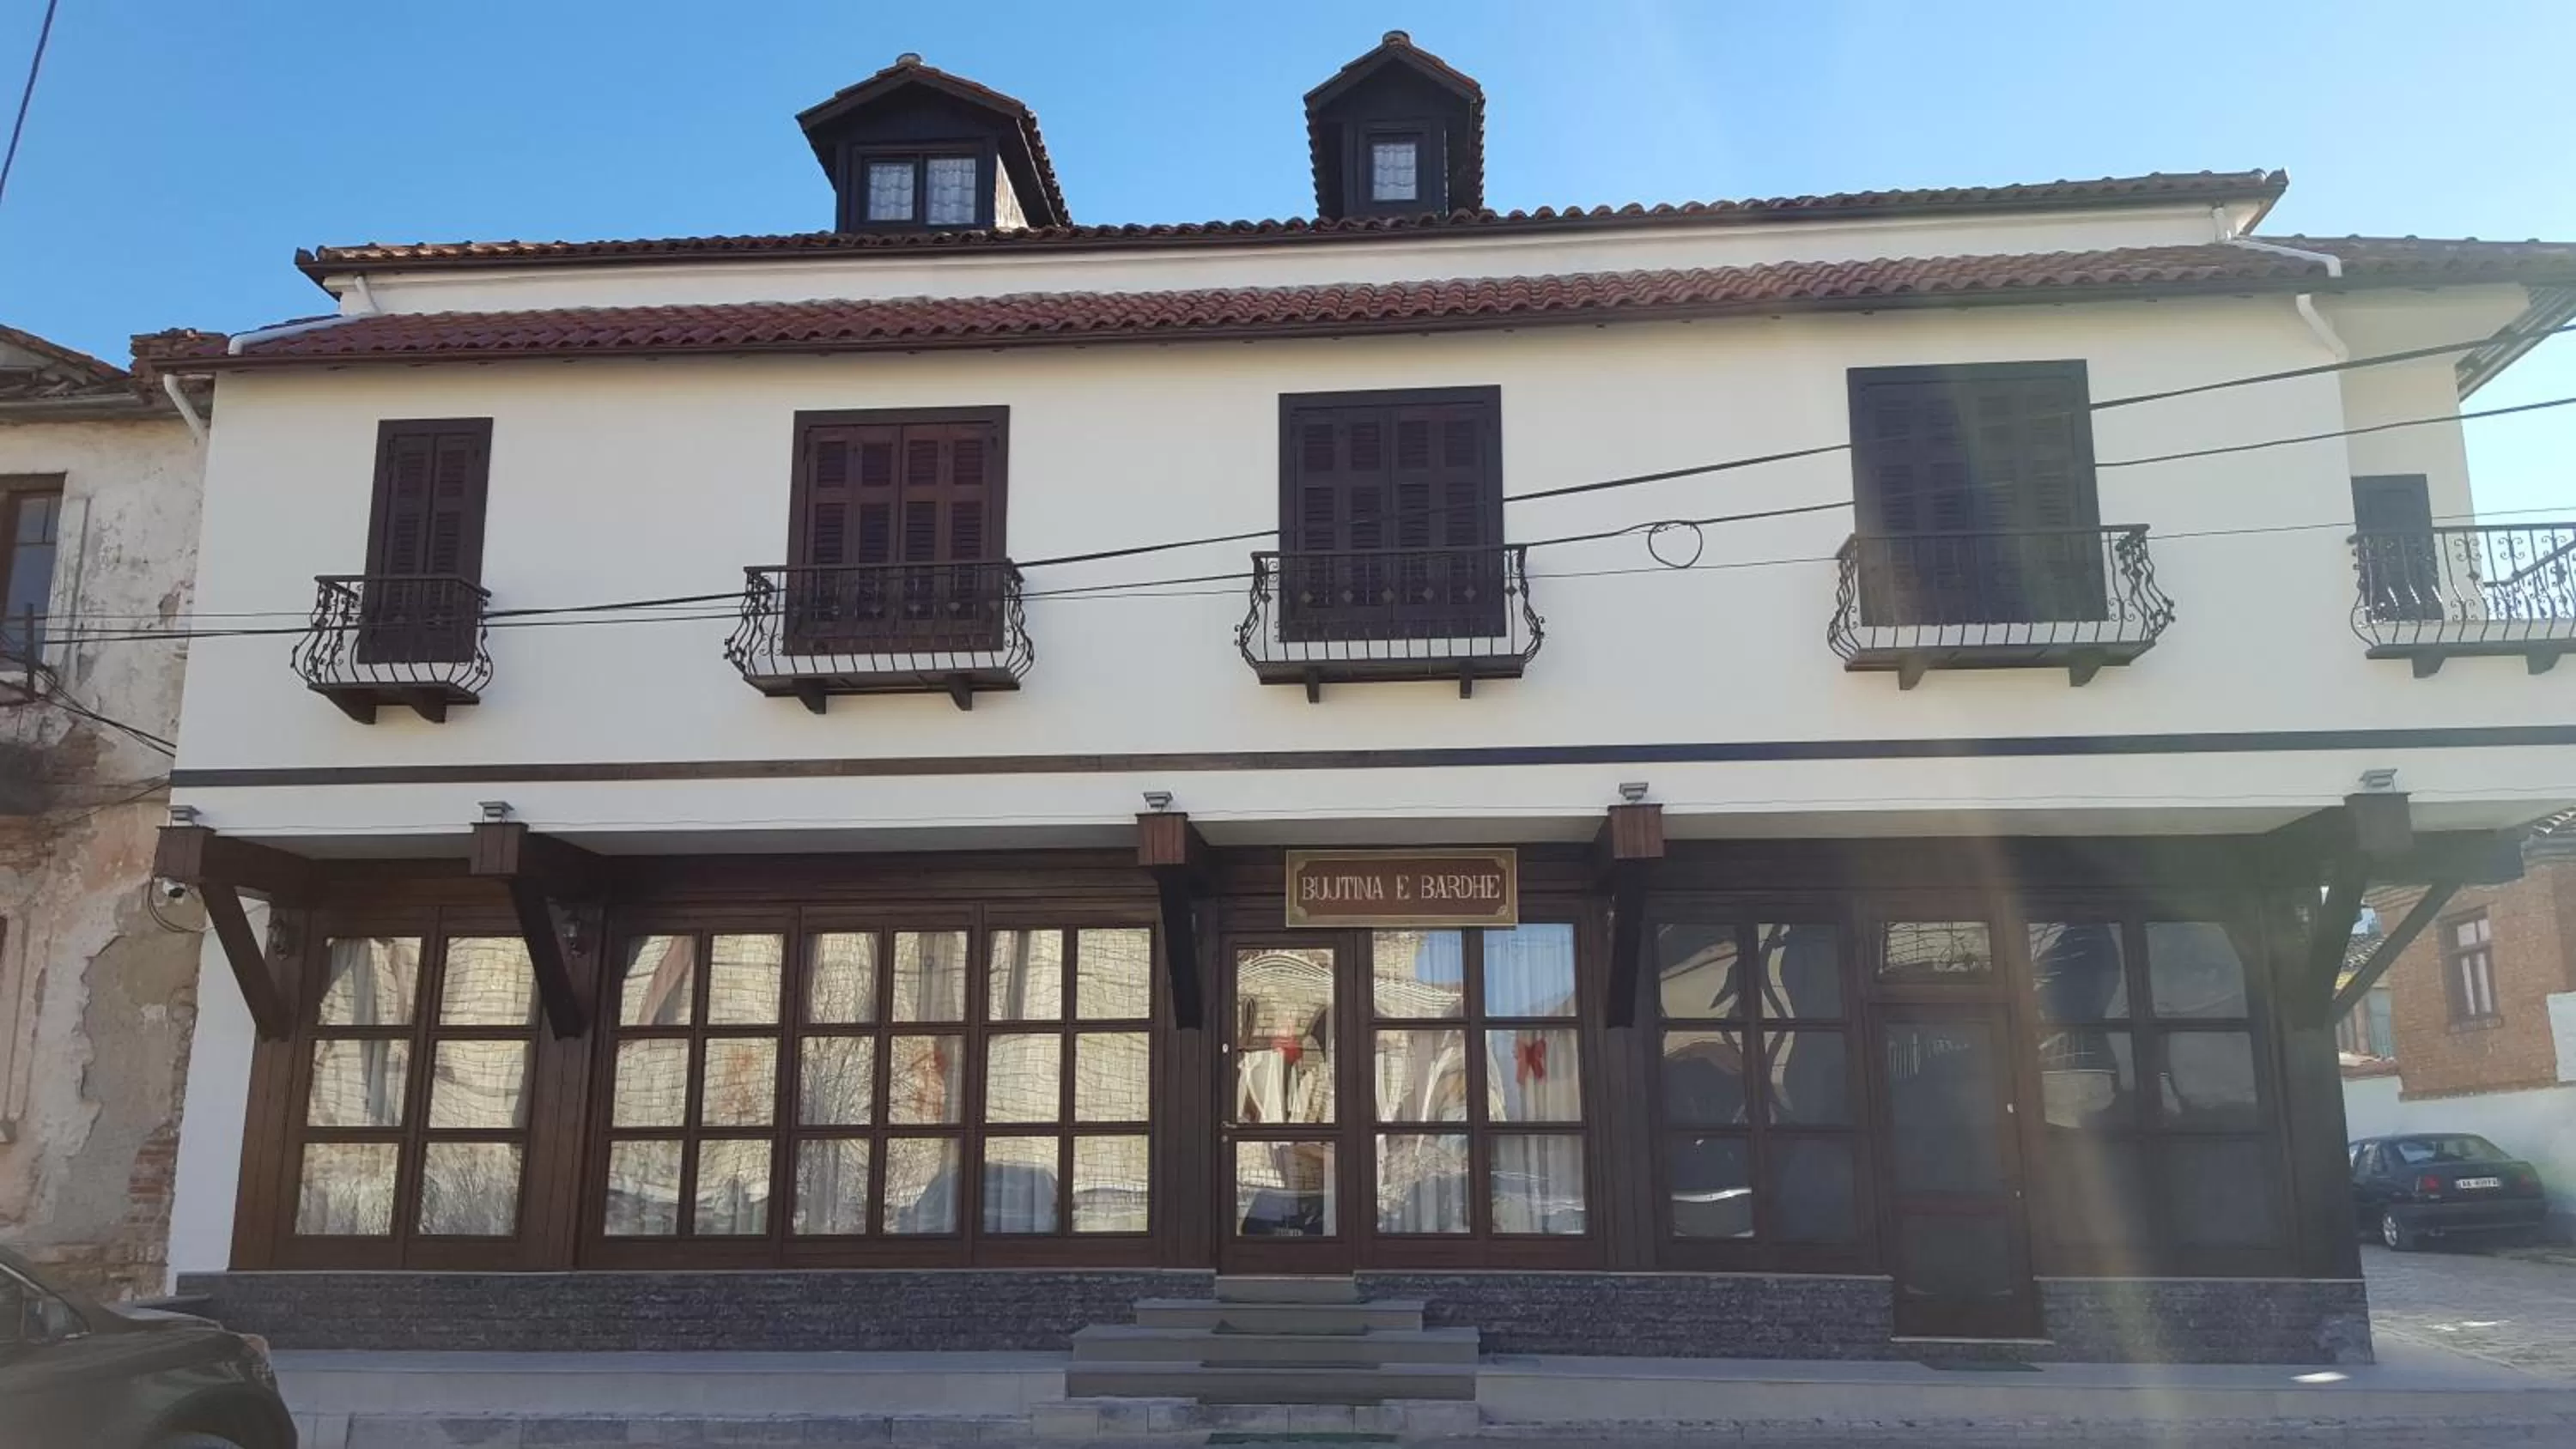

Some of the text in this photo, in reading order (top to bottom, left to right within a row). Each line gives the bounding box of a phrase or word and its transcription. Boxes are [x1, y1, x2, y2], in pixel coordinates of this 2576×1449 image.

[1302, 875, 1500, 900] BUJTINA E BARDHE
